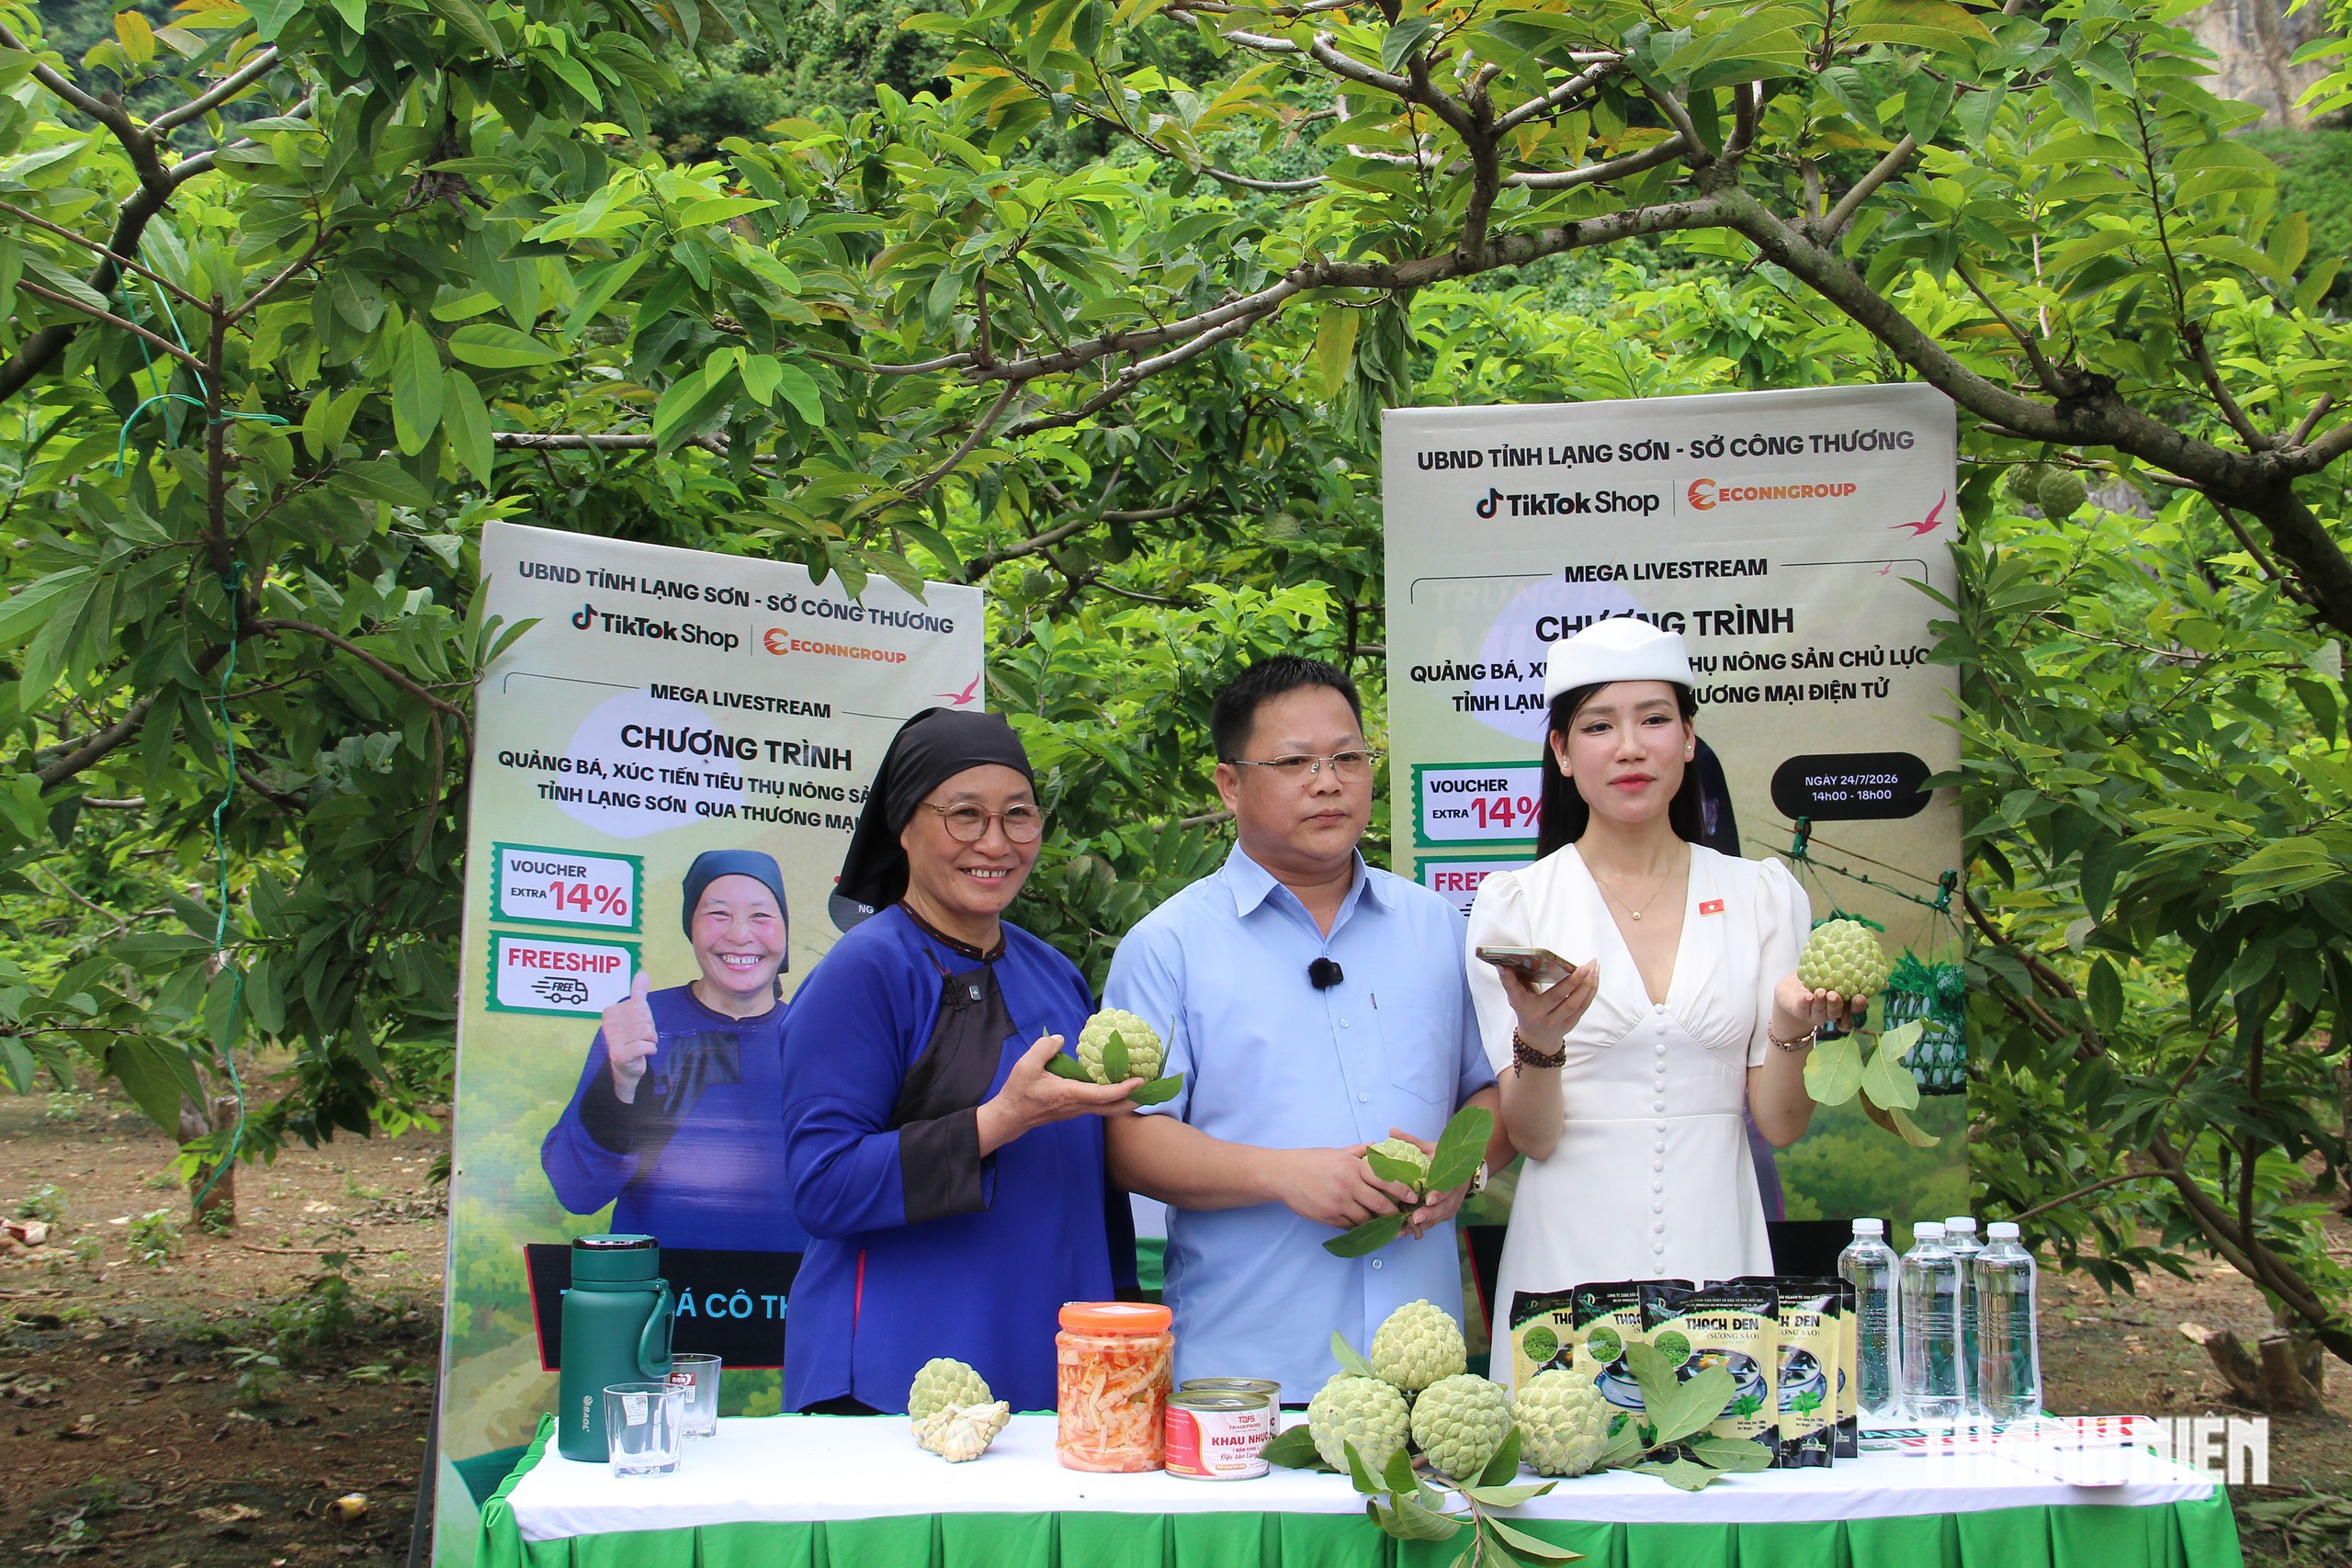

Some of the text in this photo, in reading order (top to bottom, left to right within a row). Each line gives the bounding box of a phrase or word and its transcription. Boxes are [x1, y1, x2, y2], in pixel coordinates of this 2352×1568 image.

[1418, 450, 1483, 470] UBND
[1488, 444, 1542, 468] TỈNH
[1549, 444, 1612, 469] LẠNG
[1618, 439, 1669, 462] SƠN
[1690, 434, 1724, 458] SỞ
[1730, 434, 1804, 457] CÔNG
[1809, 429, 1914, 454] THƯƠNG
[1507, 491, 1659, 516] TikTok Shop
[1719, 483, 1857, 502] ECONNGROUP
[1565, 558, 1768, 582] MEGA LIVESTREAM
[519, 561, 581, 584] UBND
[586, 568, 635, 592] TỈNH
[641, 578, 699, 600] LẠNG
[704, 587, 750, 607] SƠN
[767, 592, 797, 613] SỞ
[802, 599, 864, 622] CÔNG
[868, 608, 954, 634] THƯƠNG
[601, 613, 739, 651] TikTok Shop
[1535, 604, 1793, 642] CHNG TRÌNH
[791, 638, 906, 664] ECONNGROUP
[1688, 644, 1930, 676] HỤ NÔNG SẢN CHỦ LỰC
[1410, 660, 1486, 683] QUẢNG
[1490, 659, 1523, 682] BÁ,
[650, 683, 831, 718] MEGA LIVESTREAM
[1452, 691, 1544, 714] TỈNH LẠN
[1691, 676, 1890, 705] ƯƠNG MẠI ĐIỆN TỬ
[621, 724, 852, 772] CHƯƠNG TRÌNH
[499, 750, 870, 804] QUẢNG BÁ, XÚC TIẾN TIÊU THỤ NÔNG SẢ
[1430, 779, 1508, 793] VOUCHER
[1805, 773, 1898, 786] NGÀY 24/7/2026
[537, 780, 583, 803] TỈNH
[588, 789, 641, 809] LẠNG
[644, 795, 687, 814] SƠN
[695, 801, 737, 818] QUA
[741, 805, 821, 827] THƯƠNG
[1812, 791, 1847, 801] 14h00
[1857, 790, 1892, 800] 18h00
[1432, 795, 1543, 829] EXTRA 14%
[511, 859, 587, 878] VOUCHER
[511, 881, 628, 916] EXTRA 14%
[858, 904, 874, 914] NG
[508, 948, 621, 974] FREESHIP
[552, 982, 574, 992] FREE
[676, 1287, 696, 1317] Á
[705, 1289, 752, 1318] CÔ
[1732, 1318, 1758, 1330] ĐEN
[1212, 1431, 1268, 1446] KHAU NHỤC
